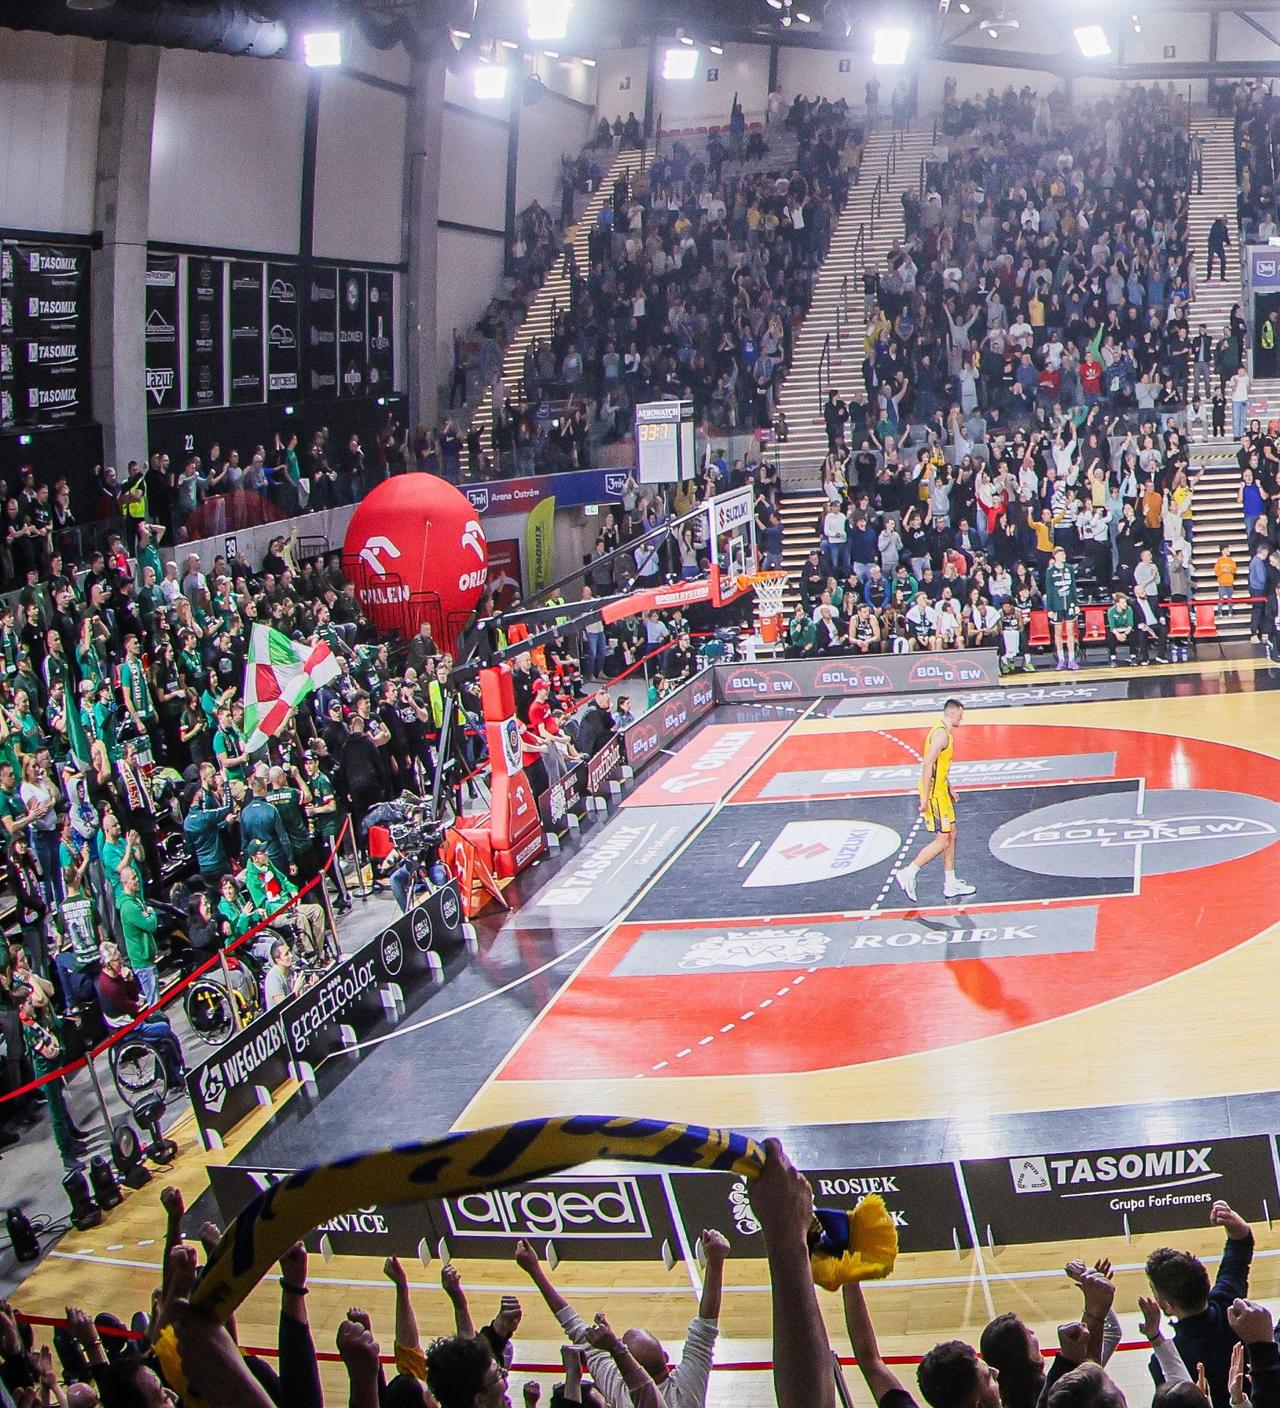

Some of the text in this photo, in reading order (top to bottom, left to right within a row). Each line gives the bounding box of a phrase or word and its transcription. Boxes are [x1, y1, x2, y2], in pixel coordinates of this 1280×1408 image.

[40, 256, 77, 270] TASOMIX
[39, 301, 77, 314] TASOMIX
[38, 344, 77, 358] TASOMIX
[38, 388, 77, 403] TASOMIX
[184, 434, 195, 450] 22
[491, 491, 511, 502] Arena
[725, 502, 749, 522] SUZUKI
[227, 539, 236, 557] 39
[690, 730, 756, 770] ORLEN
[1032, 821, 1245, 843] BOLDREW
[561, 824, 646, 888] TASOMIX
[830, 827, 872, 869] SUZUKI
[848, 923, 1040, 951] ROSIEK
[291, 956, 376, 1053] graficolor
[1051, 1146, 1212, 1185] TASOMIX
[818, 1176, 901, 1195] ROSIEK
[459, 1178, 636, 1235] airged
[1109, 1191, 1213, 1212] Grupa ForFarmers
